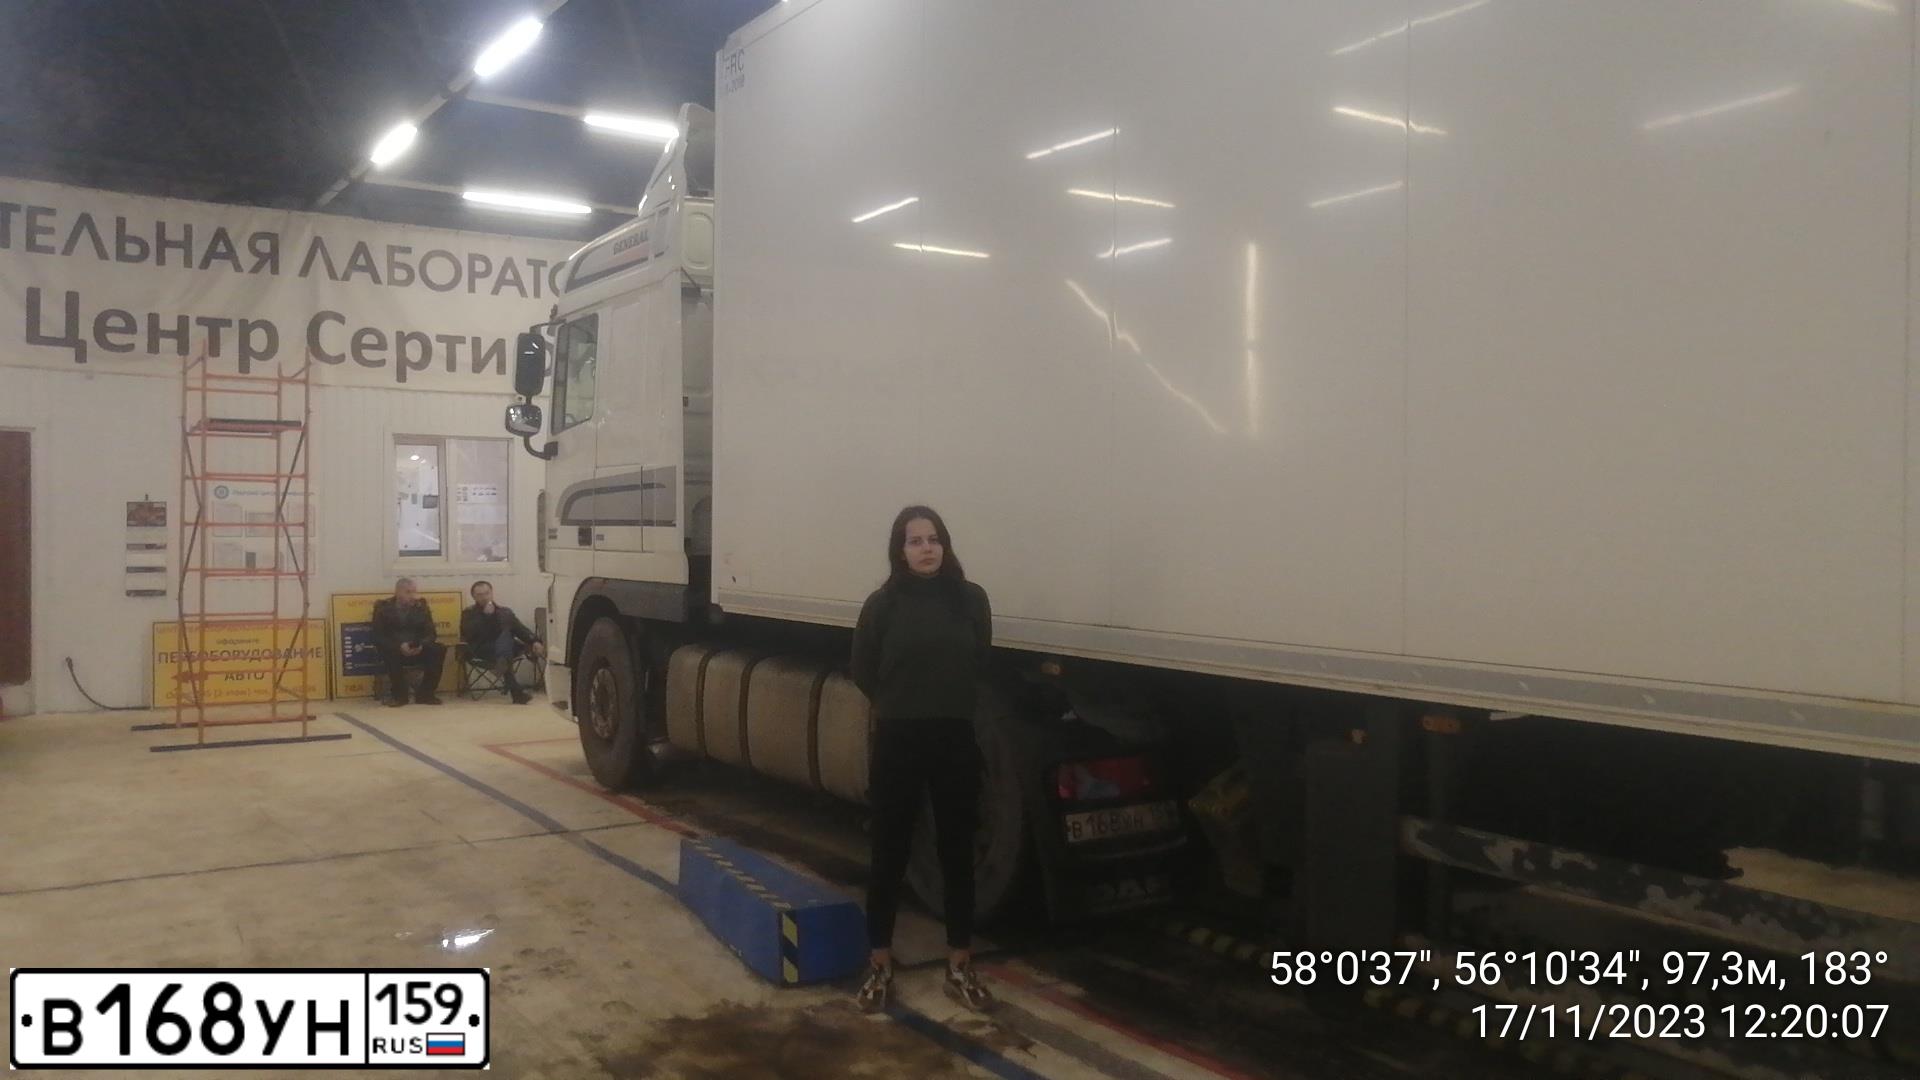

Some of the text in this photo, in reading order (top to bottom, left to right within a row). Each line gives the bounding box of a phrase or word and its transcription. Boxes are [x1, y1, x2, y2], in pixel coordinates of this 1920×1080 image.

[0, 202, 280, 275] ТЕЛЬНАЯ
[26, 286, 555, 383] Центр Серти
